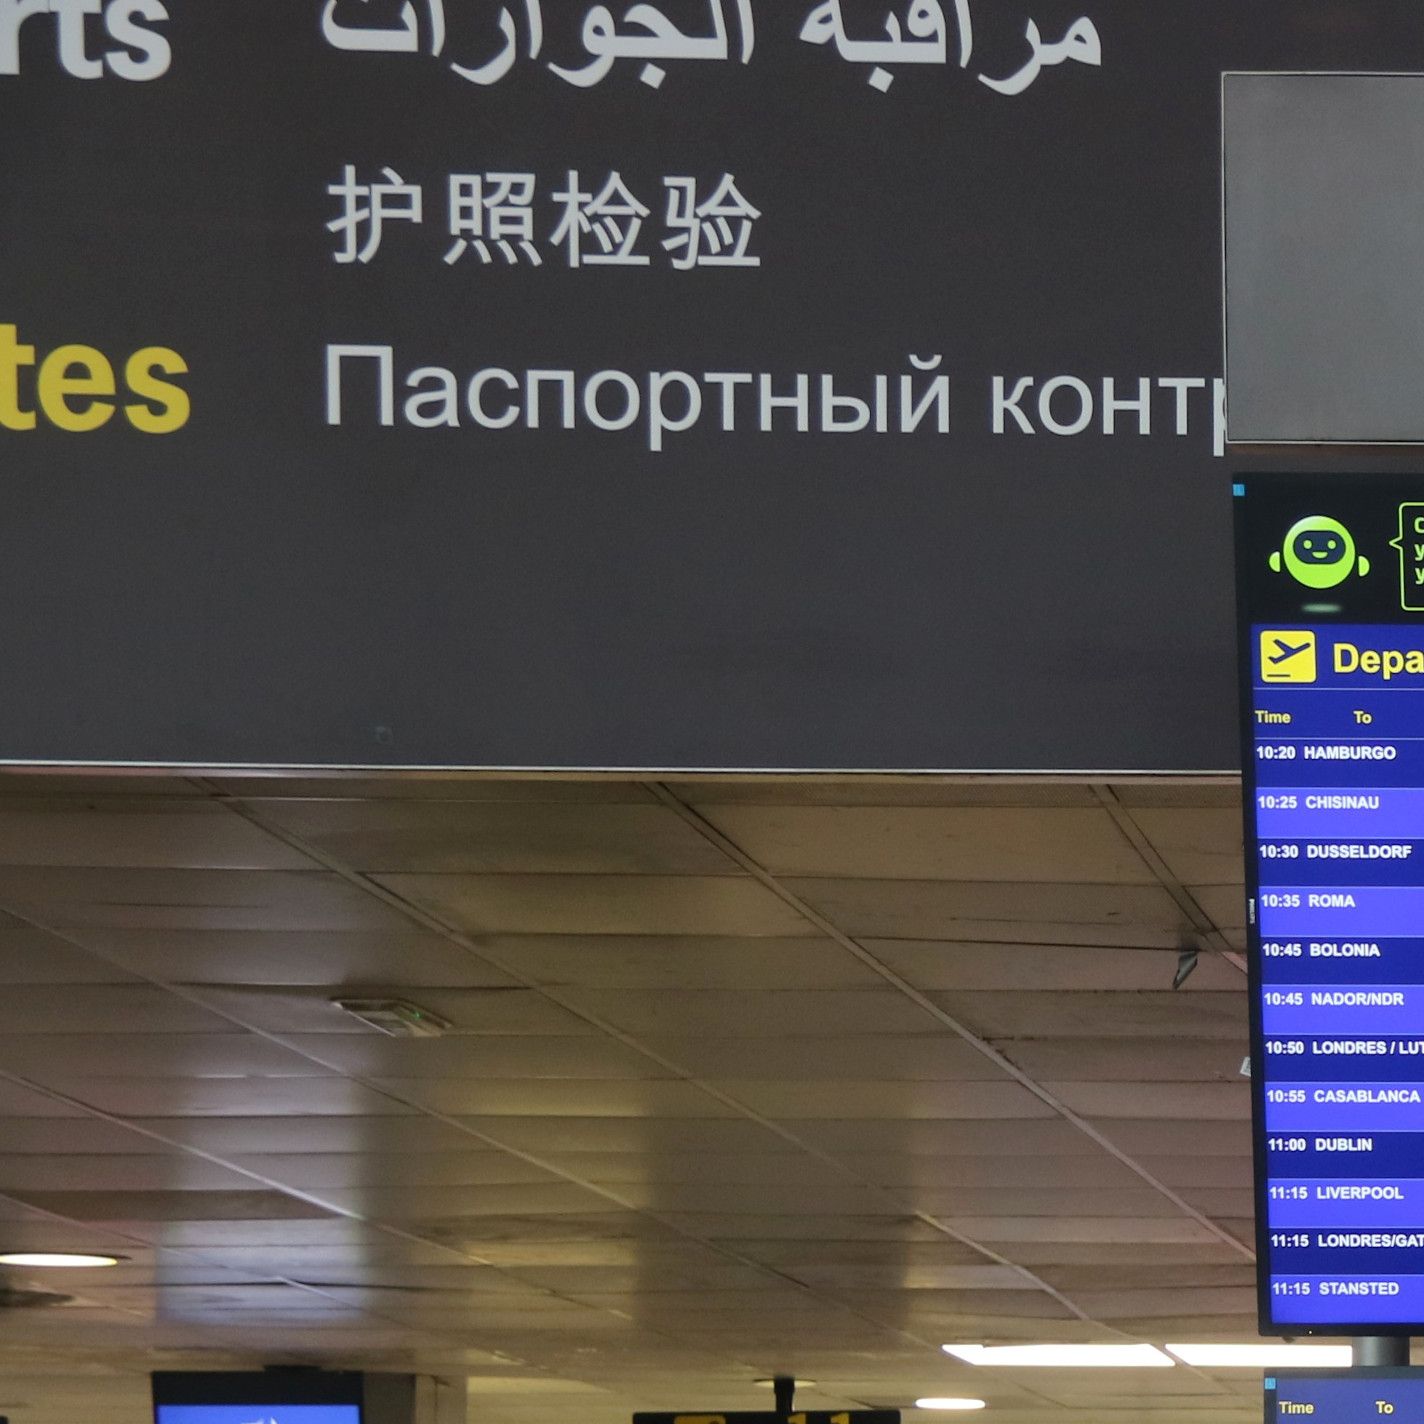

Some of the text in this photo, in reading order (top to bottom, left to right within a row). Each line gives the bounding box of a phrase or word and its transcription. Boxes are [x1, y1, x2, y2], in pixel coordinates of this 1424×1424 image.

[327, 165, 761, 270] 护照检验
[327, 344, 949, 451] Паспортный
[1255, 710, 1291, 723] Time
[1354, 711, 1371, 723] To
[1257, 746, 1295, 759] 10:20
[1304, 746, 1396, 759] HAMBURGO
[1267, 1090, 1305, 1102] 10:55
[1314, 1090, 1420, 1102] CASABLANCA
